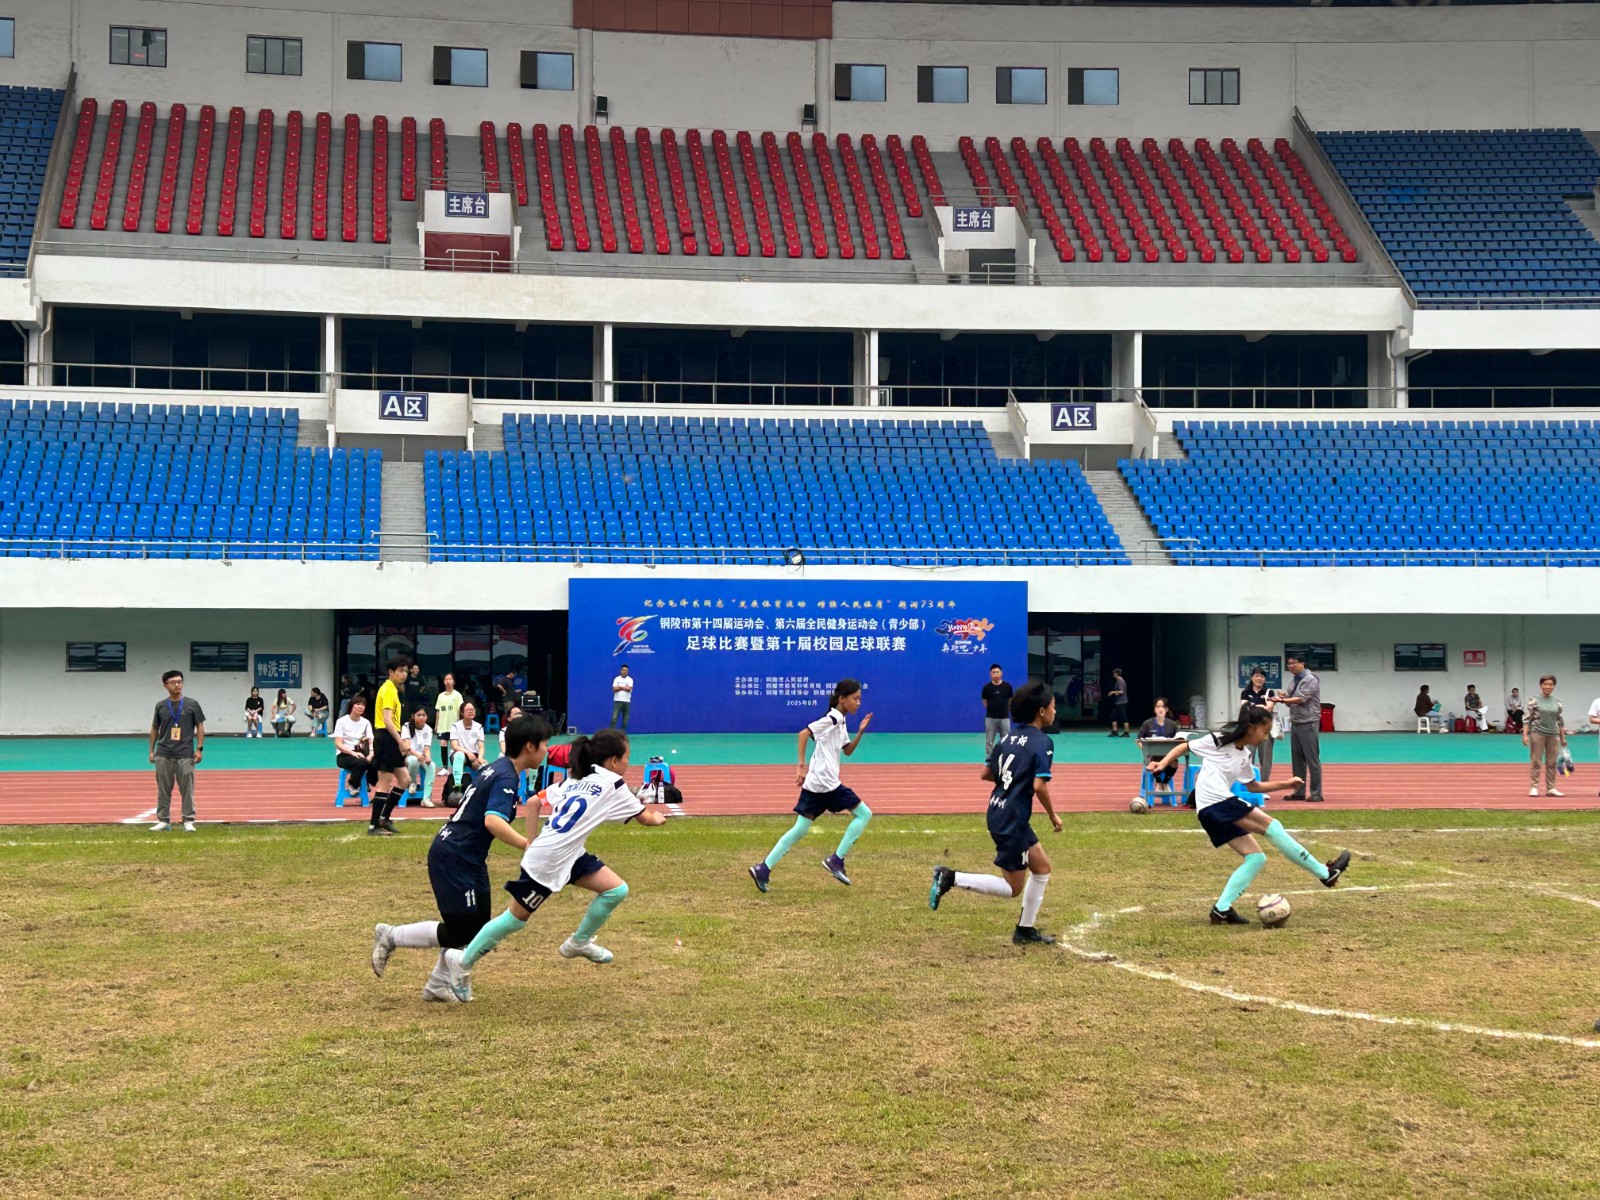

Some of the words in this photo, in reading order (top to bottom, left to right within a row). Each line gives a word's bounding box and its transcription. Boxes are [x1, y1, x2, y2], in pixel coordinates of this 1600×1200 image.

[449, 195, 486, 215] 主席台
[956, 210, 991, 228] 主席台
[383, 395, 423, 417] A区
[1055, 407, 1092, 427] A区
[686, 635, 907, 651] 足球比赛暨第十届校园足球联赛
[268, 660, 300, 678] 洗手间
[998, 753, 1015, 790] 14
[464, 889, 477, 907] 11
[522, 890, 544, 909] 10
